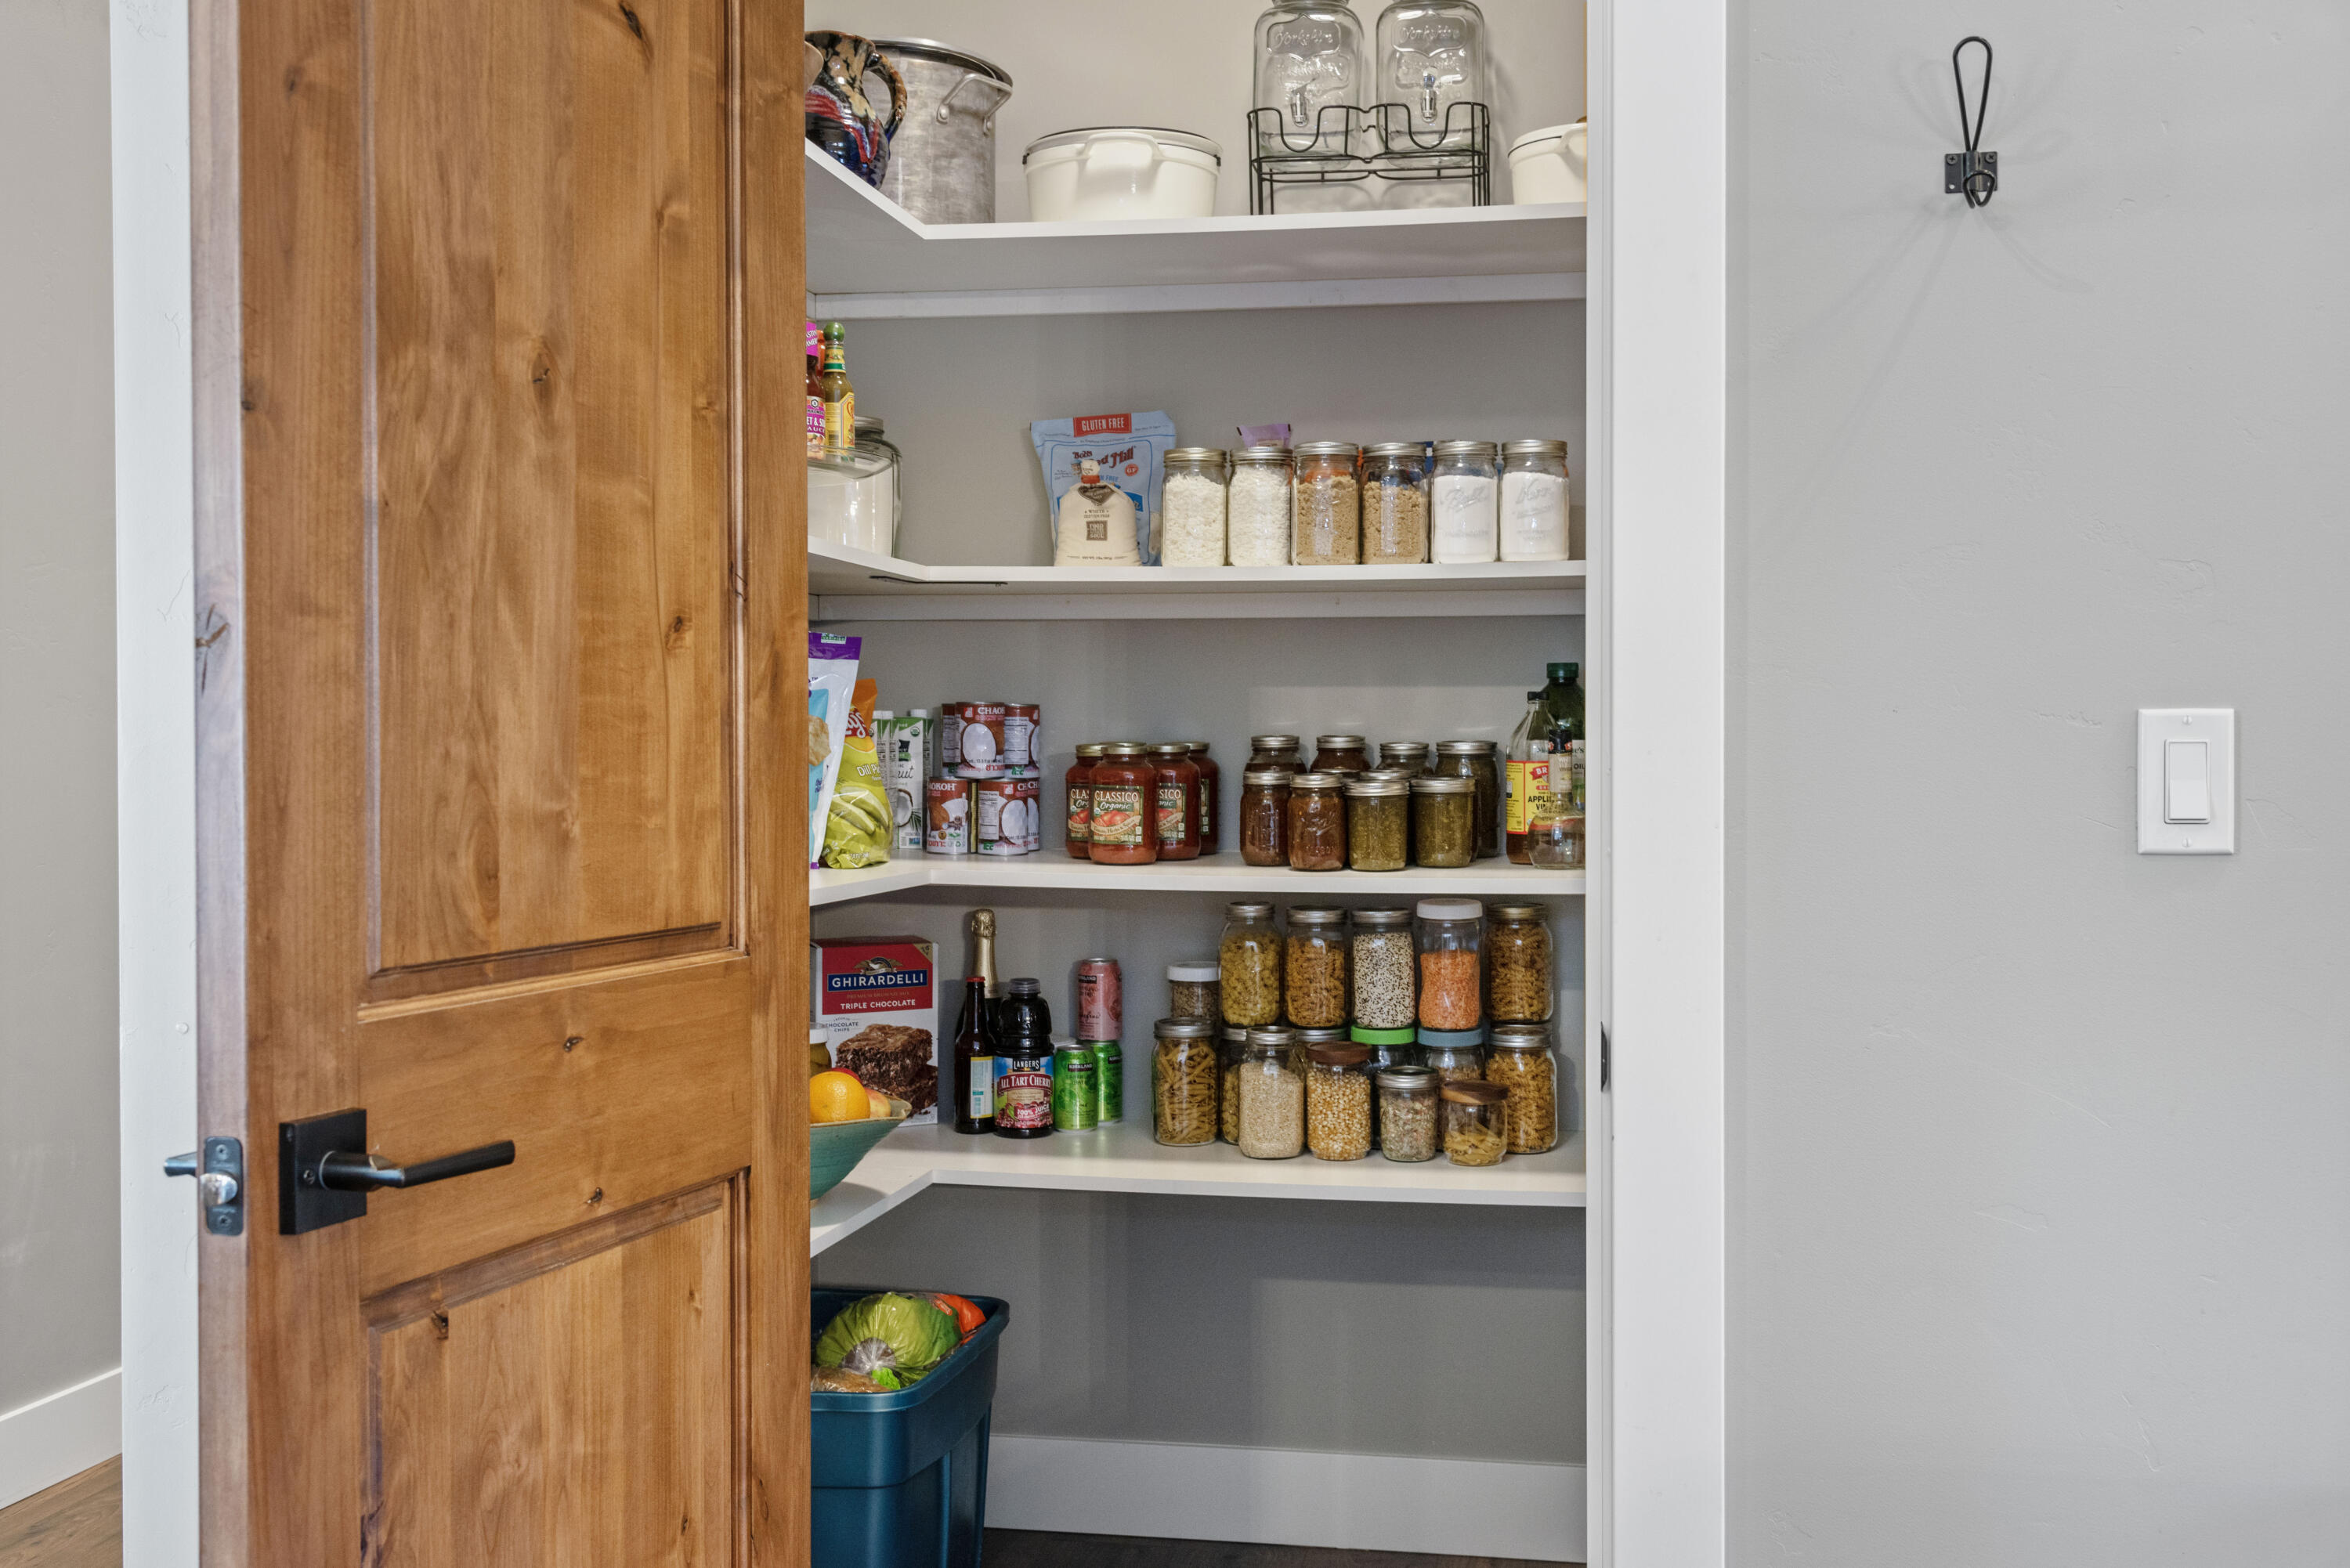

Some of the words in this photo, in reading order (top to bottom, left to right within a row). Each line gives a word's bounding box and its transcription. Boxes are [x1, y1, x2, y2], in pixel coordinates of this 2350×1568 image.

[1081, 419, 1107, 432] GLUTEN
[1108, 417, 1125, 429] FREE
[856, 764, 872, 777] Dill
[1094, 790, 1139, 802] CLASSICO
[1159, 789, 1181, 799] SICO
[1100, 801, 1131, 811] Organic
[832, 973, 924, 988] GHIRARDELLI
[870, 999, 916, 1009] CHOCOLATE
[1014, 1060, 1039, 1070] LANGERS
[1010, 1075, 1029, 1087] TART
